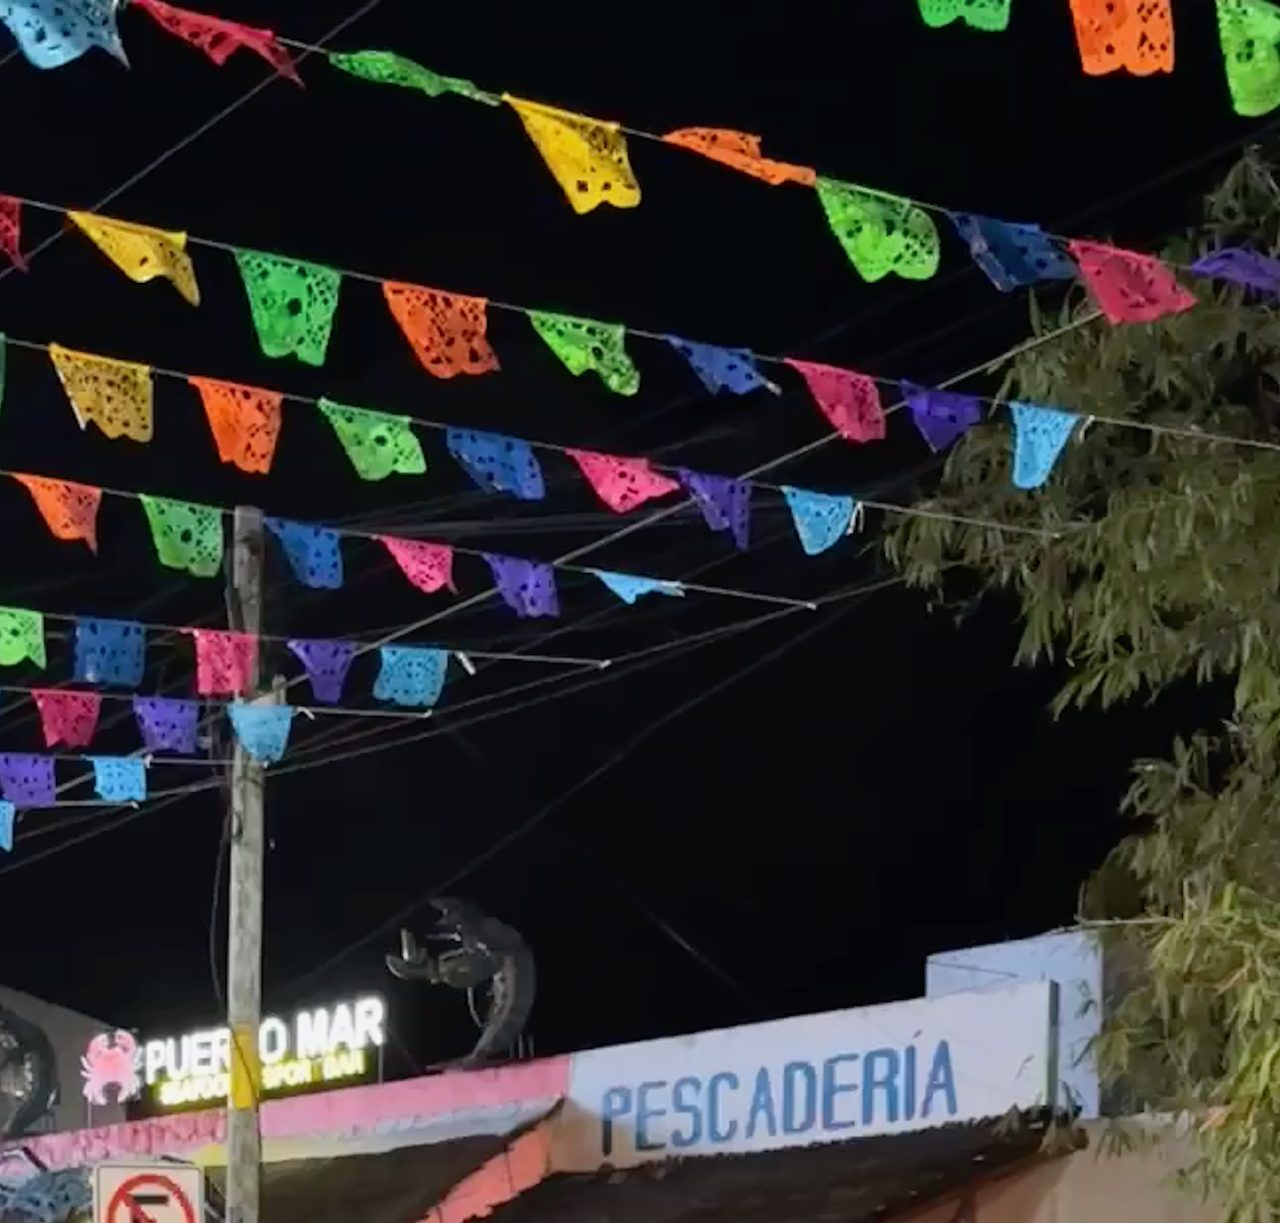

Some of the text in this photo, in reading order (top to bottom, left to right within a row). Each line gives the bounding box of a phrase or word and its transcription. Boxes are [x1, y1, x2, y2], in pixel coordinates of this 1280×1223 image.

[146, 997, 384, 1085] PUERO MAR
[602, 1030, 957, 1155] PESCADERÍA
